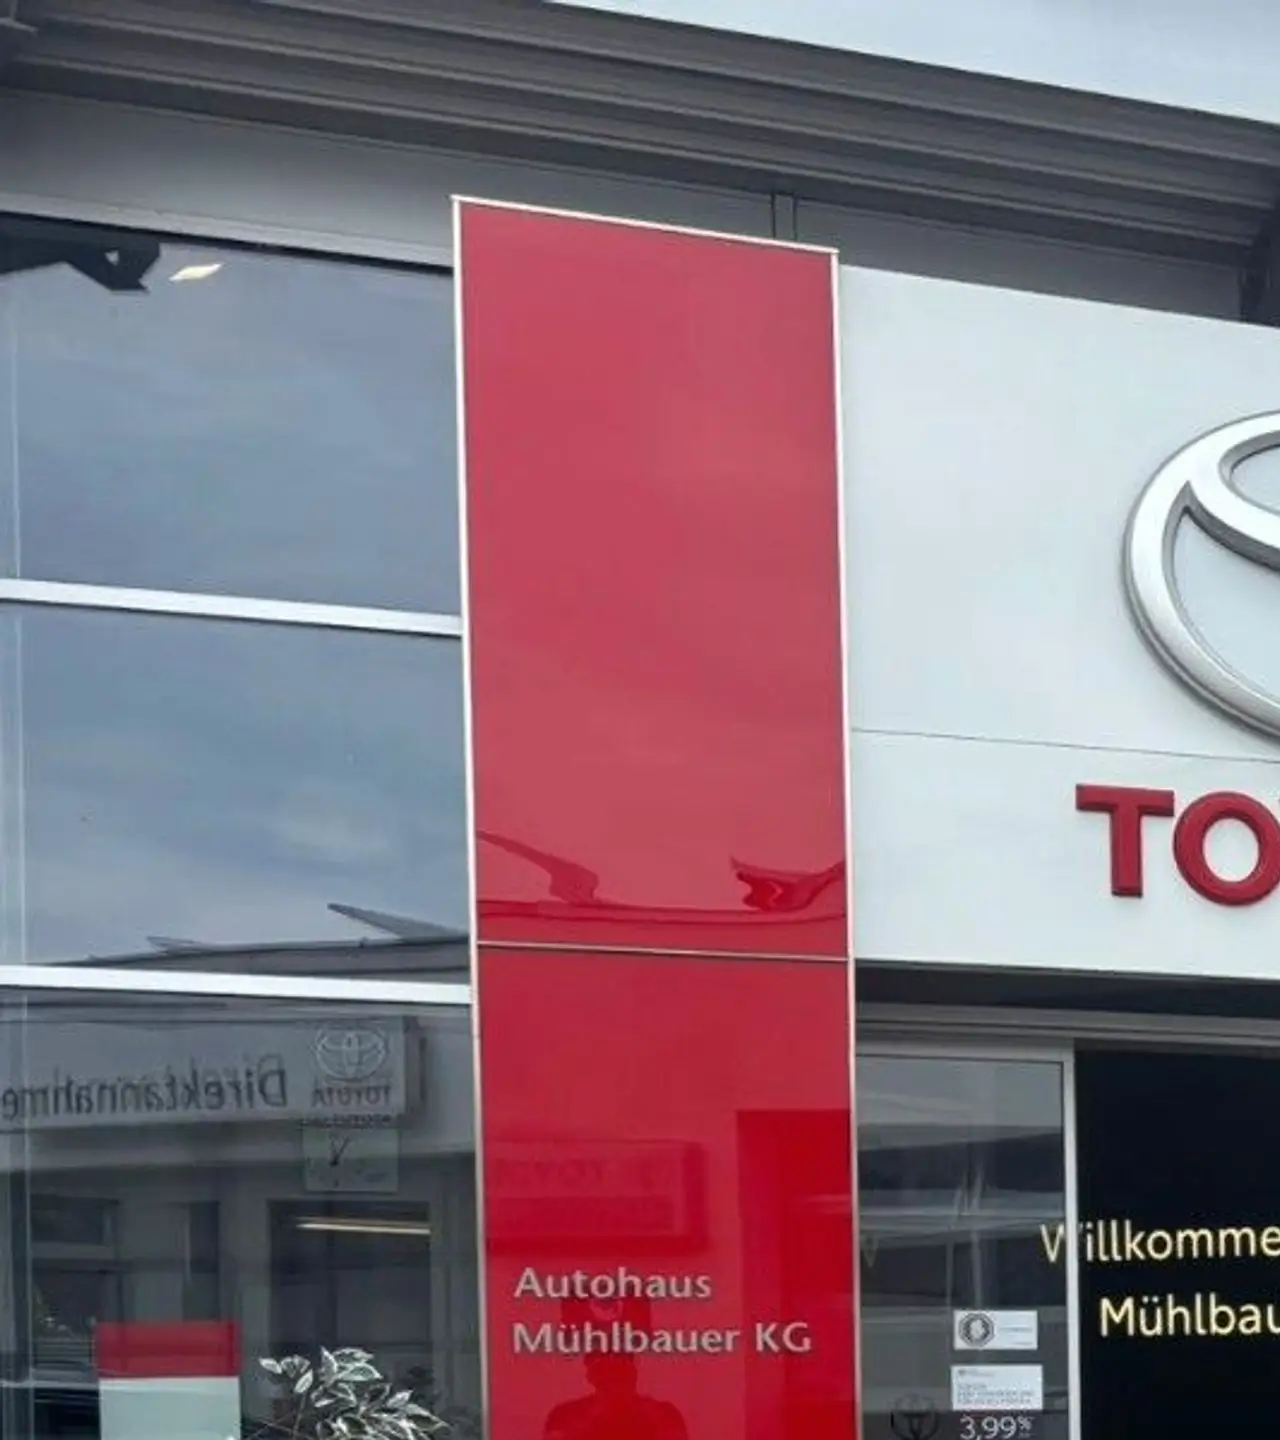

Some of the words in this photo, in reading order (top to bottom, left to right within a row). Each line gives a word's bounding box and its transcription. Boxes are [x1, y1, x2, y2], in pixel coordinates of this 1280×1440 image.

[513, 1266, 713, 1299] Autohaus
[511, 1321, 742, 1354] Mühlbauer
[754, 1321, 812, 1353] KG
